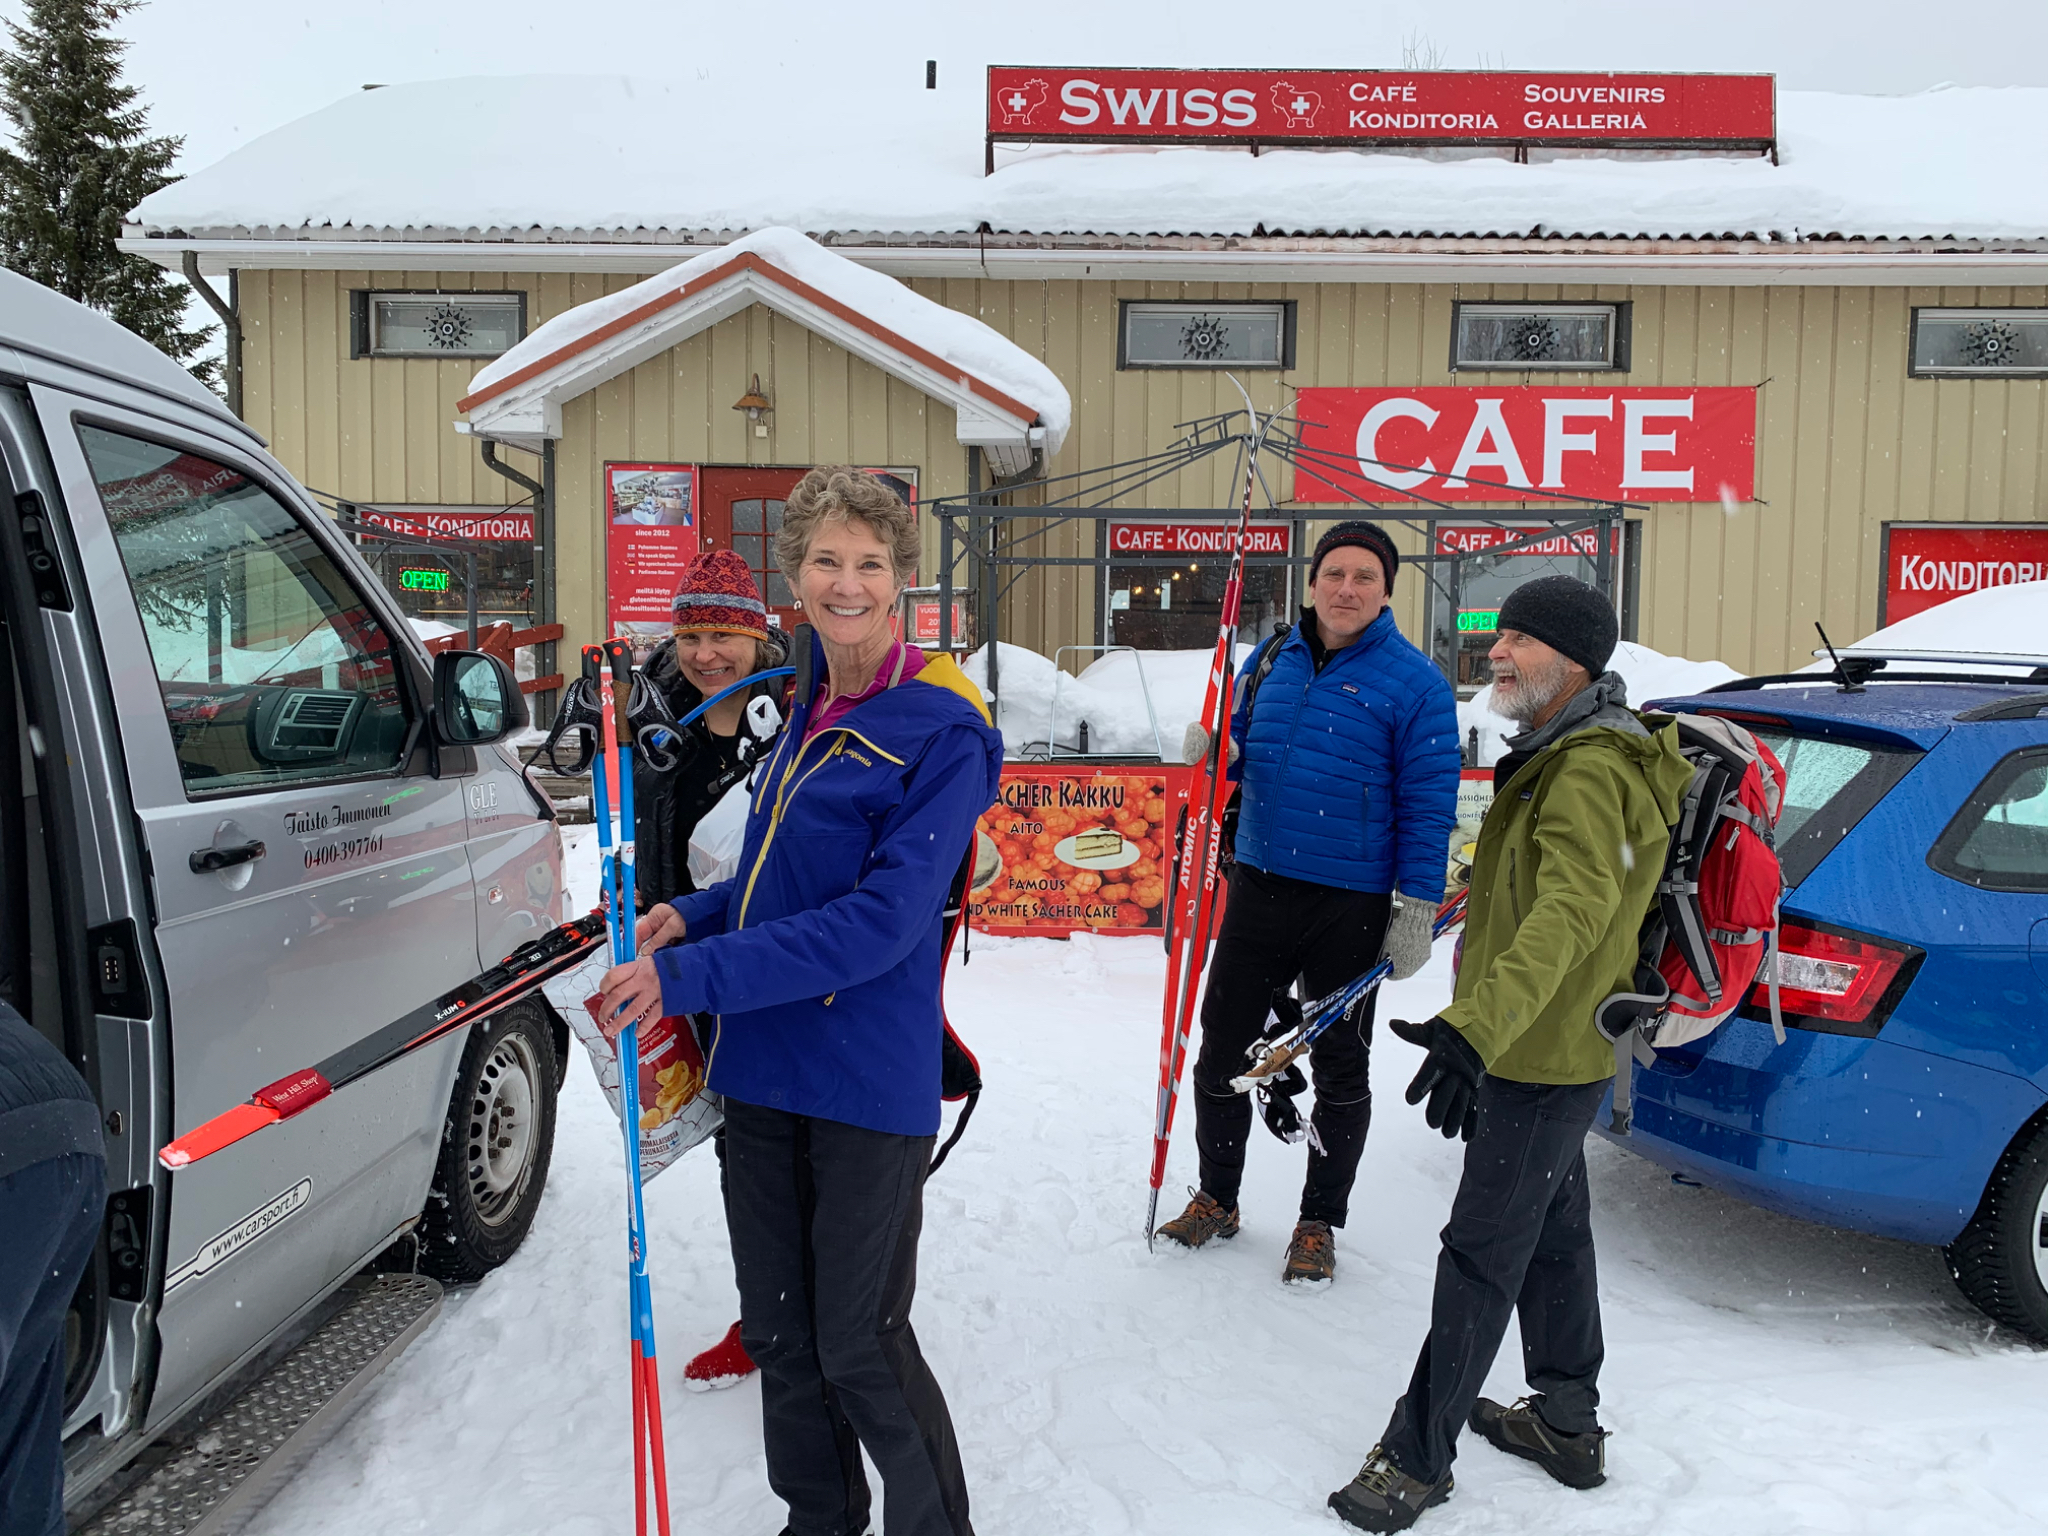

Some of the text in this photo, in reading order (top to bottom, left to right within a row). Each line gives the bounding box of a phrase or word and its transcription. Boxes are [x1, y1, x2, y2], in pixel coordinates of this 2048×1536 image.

[1059, 78, 1257, 127] SWISS
[1348, 81, 1417, 104] CAFÉ
[1524, 84, 1666, 105] SOUVENIRS
[1348, 109, 1499, 131] KONDITORIA
[1524, 110, 1648, 131] GALLERIA
[1355, 394, 1695, 493] CAFE
[427, 515, 532, 538] KONDITORIA
[653, 529, 671, 537] 2012
[1116, 527, 1164, 550] CAFE
[1442, 530, 1491, 553] CAFE
[402, 570, 447, 590] OPEN
[1901, 555, 2048, 591] KONDITORI
[470, 782, 498, 811] GLE
[995, 780, 1126, 809] ACHER KAKKU
[1010, 822, 1043, 835] AITO
[304, 834, 385, 869] 0400-397761
[1179, 817, 1198, 890] ATOMIC
[1205, 817, 1221, 892] ATOMIC
[1008, 878, 1066, 891] FAMOUS
[968, 902, 1118, 919] ND WHITE SACHER CAKE
[212, 1187, 299, 1259] www.carsport.fi
